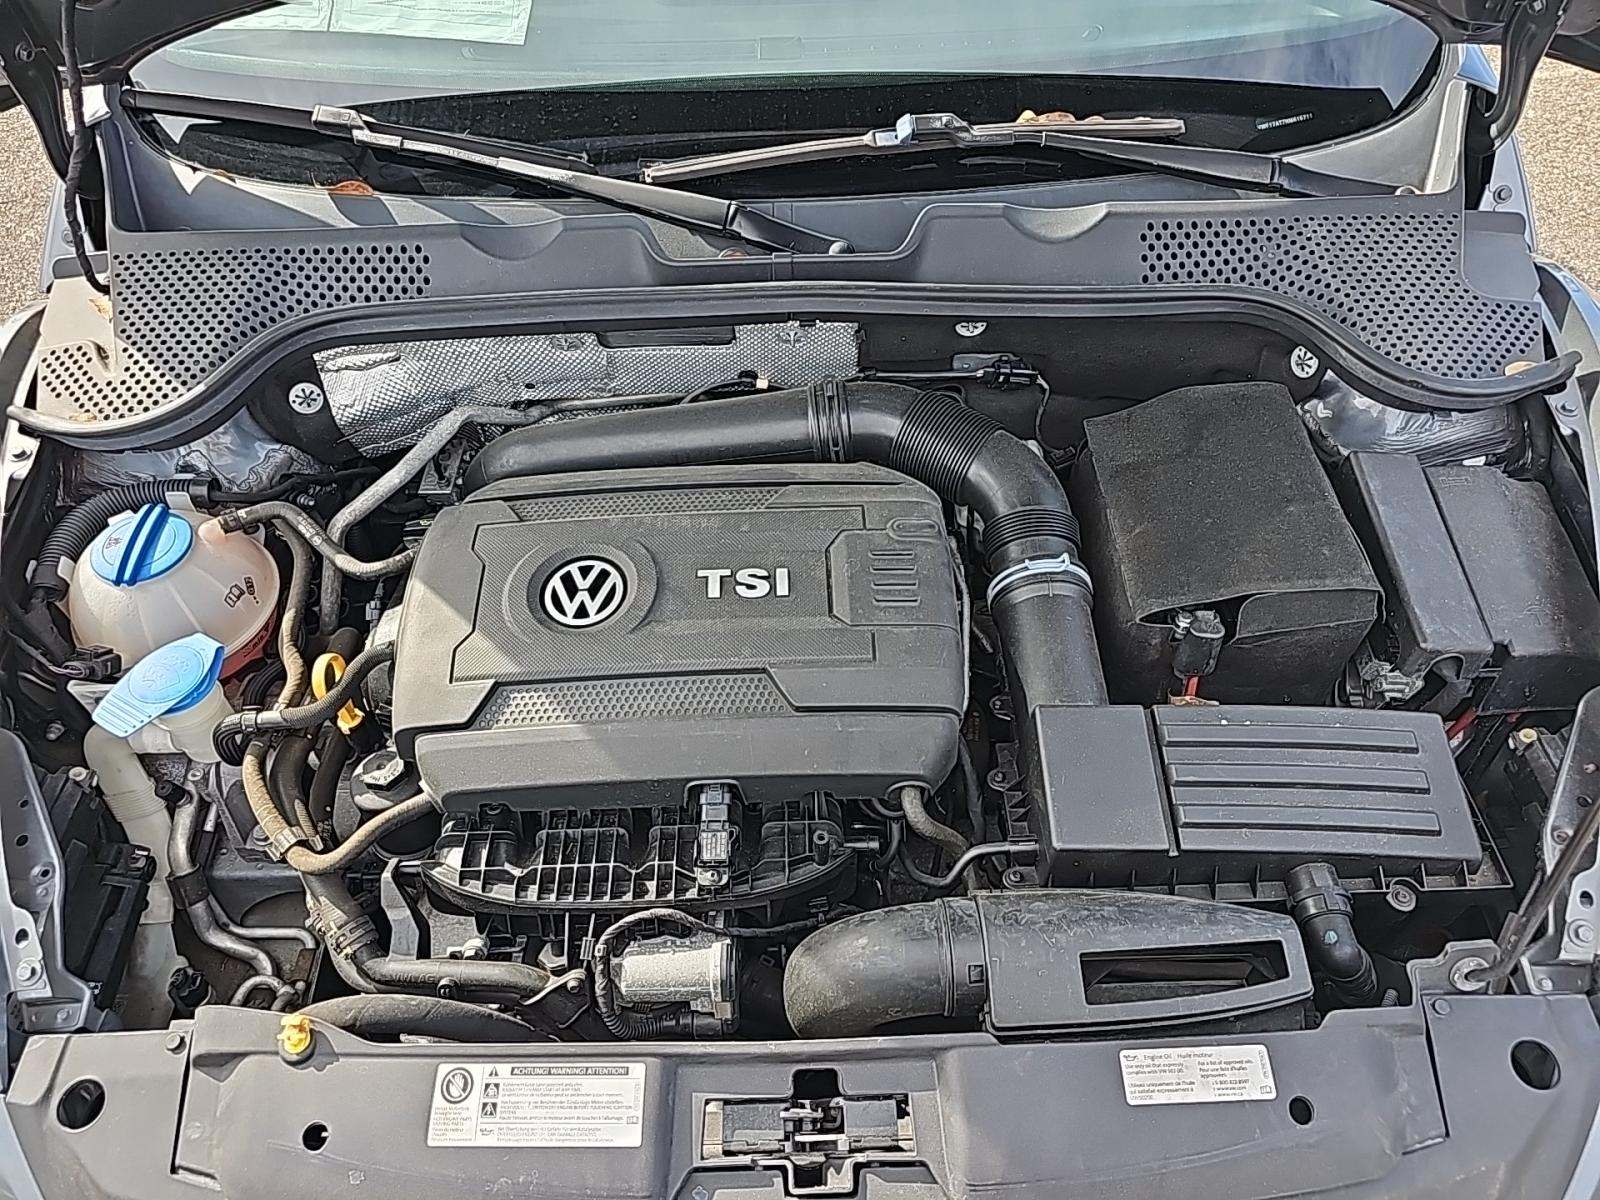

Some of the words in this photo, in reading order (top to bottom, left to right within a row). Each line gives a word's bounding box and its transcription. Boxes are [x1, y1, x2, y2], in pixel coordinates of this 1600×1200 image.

[544, 559, 624, 626] VW
[697, 567, 790, 599] TSI
[513, 1067, 549, 1075] ACHTUNG!
[550, 1067, 586, 1075] WARNING!
[587, 1067, 627, 1075] ATTENTION!
